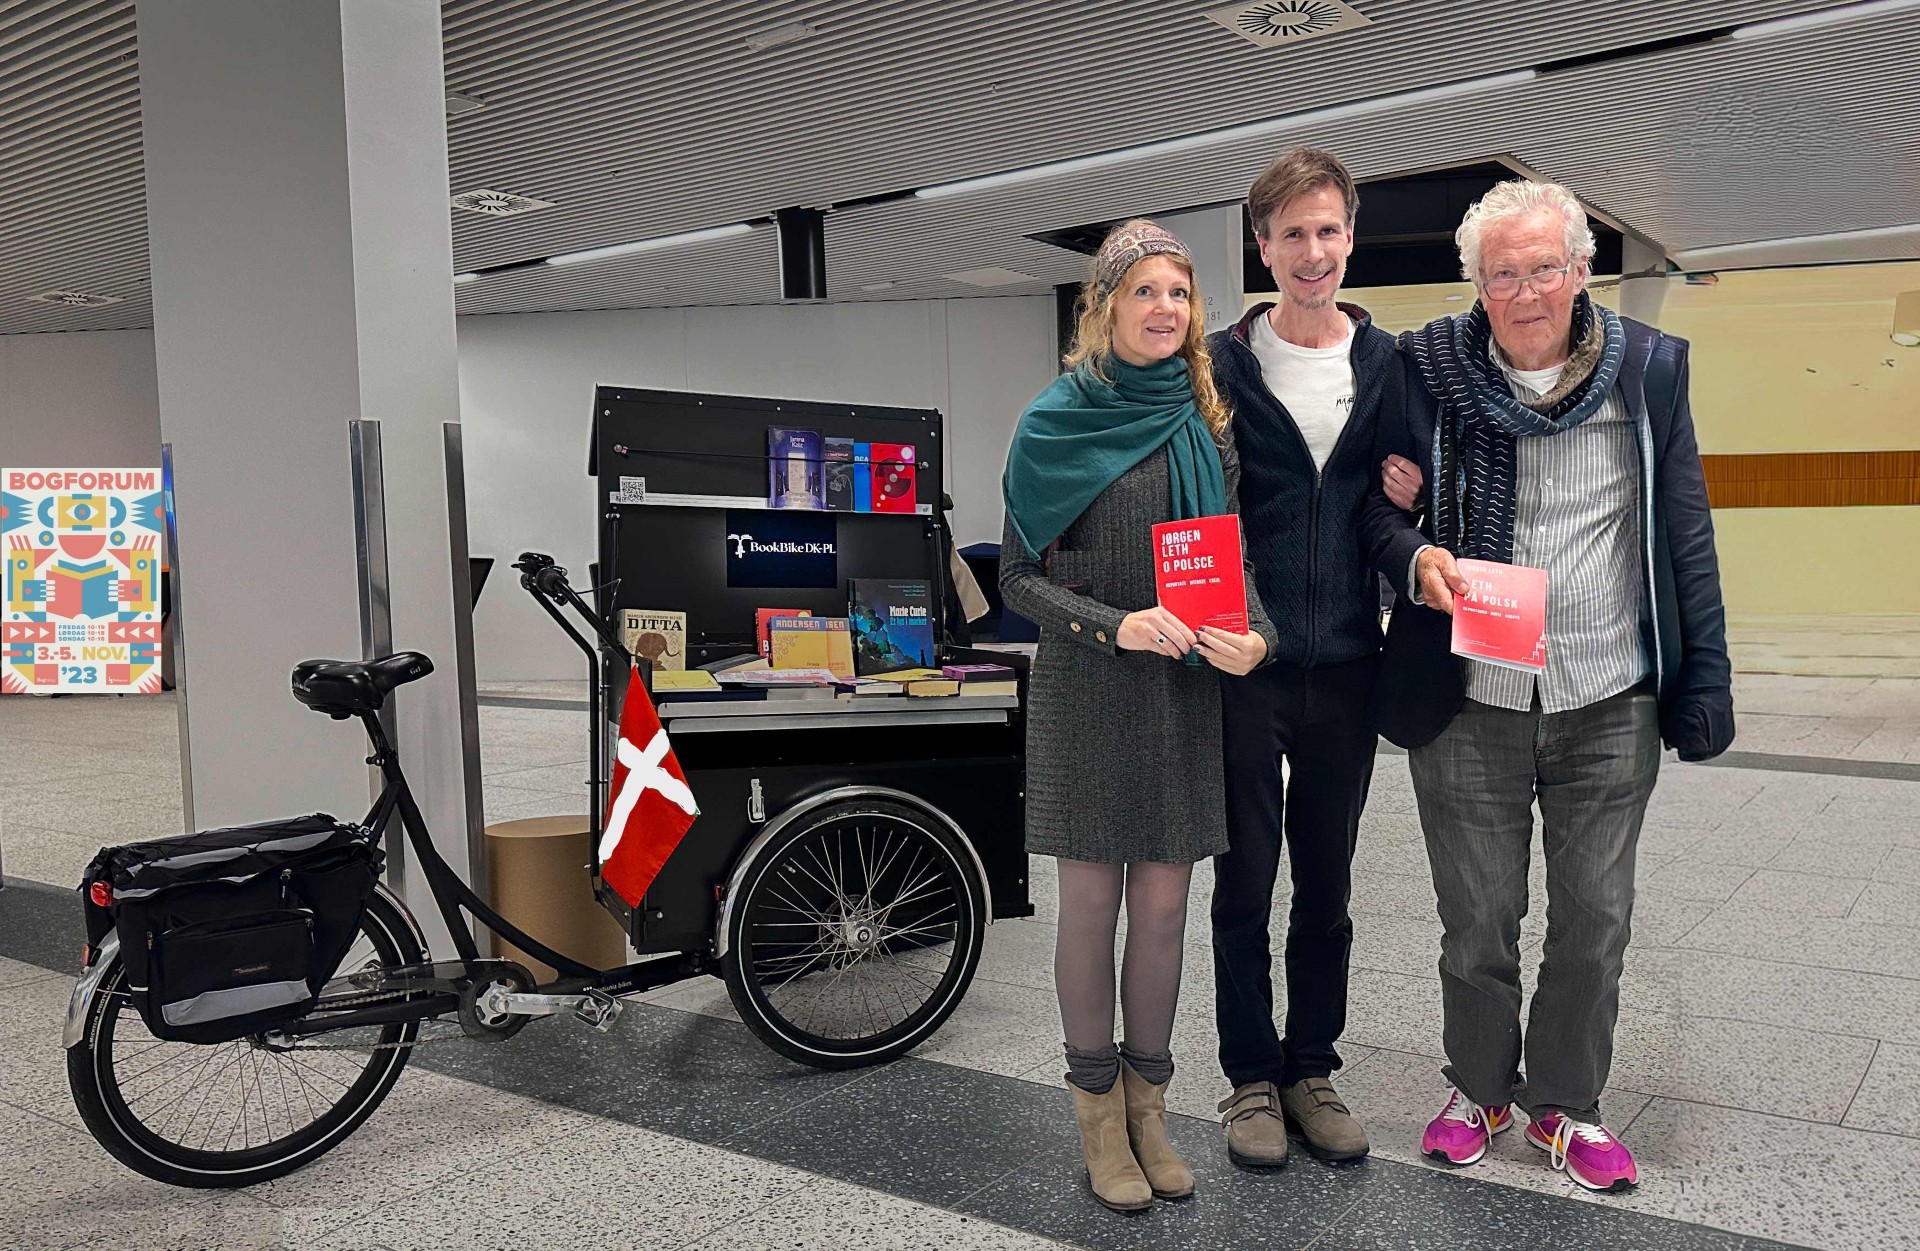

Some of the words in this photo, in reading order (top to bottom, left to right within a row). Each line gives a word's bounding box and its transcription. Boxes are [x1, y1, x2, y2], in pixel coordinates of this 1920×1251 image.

[9, 472, 155, 490] BOGFORUM
[1162, 530, 1200, 545] JØRGEN
[750, 541, 804, 553] BookBike
[805, 543, 837, 554] DK-PL
[1162, 543, 1189, 557] LETH
[1163, 561, 1170, 572] O
[1173, 556, 1214, 571] POLSCE
[1471, 579, 1492, 591] ETH
[1482, 595, 1518, 608] POLSK
[889, 605, 909, 617] Marie
[909, 605, 927, 617] Curie
[626, 618, 683, 631] DITTA
[776, 620, 820, 628] ANDERSEN
[37, 646, 77, 661] 3.-5.
[82, 646, 128, 661] NOV.
[409, 665, 421, 675] Gel
